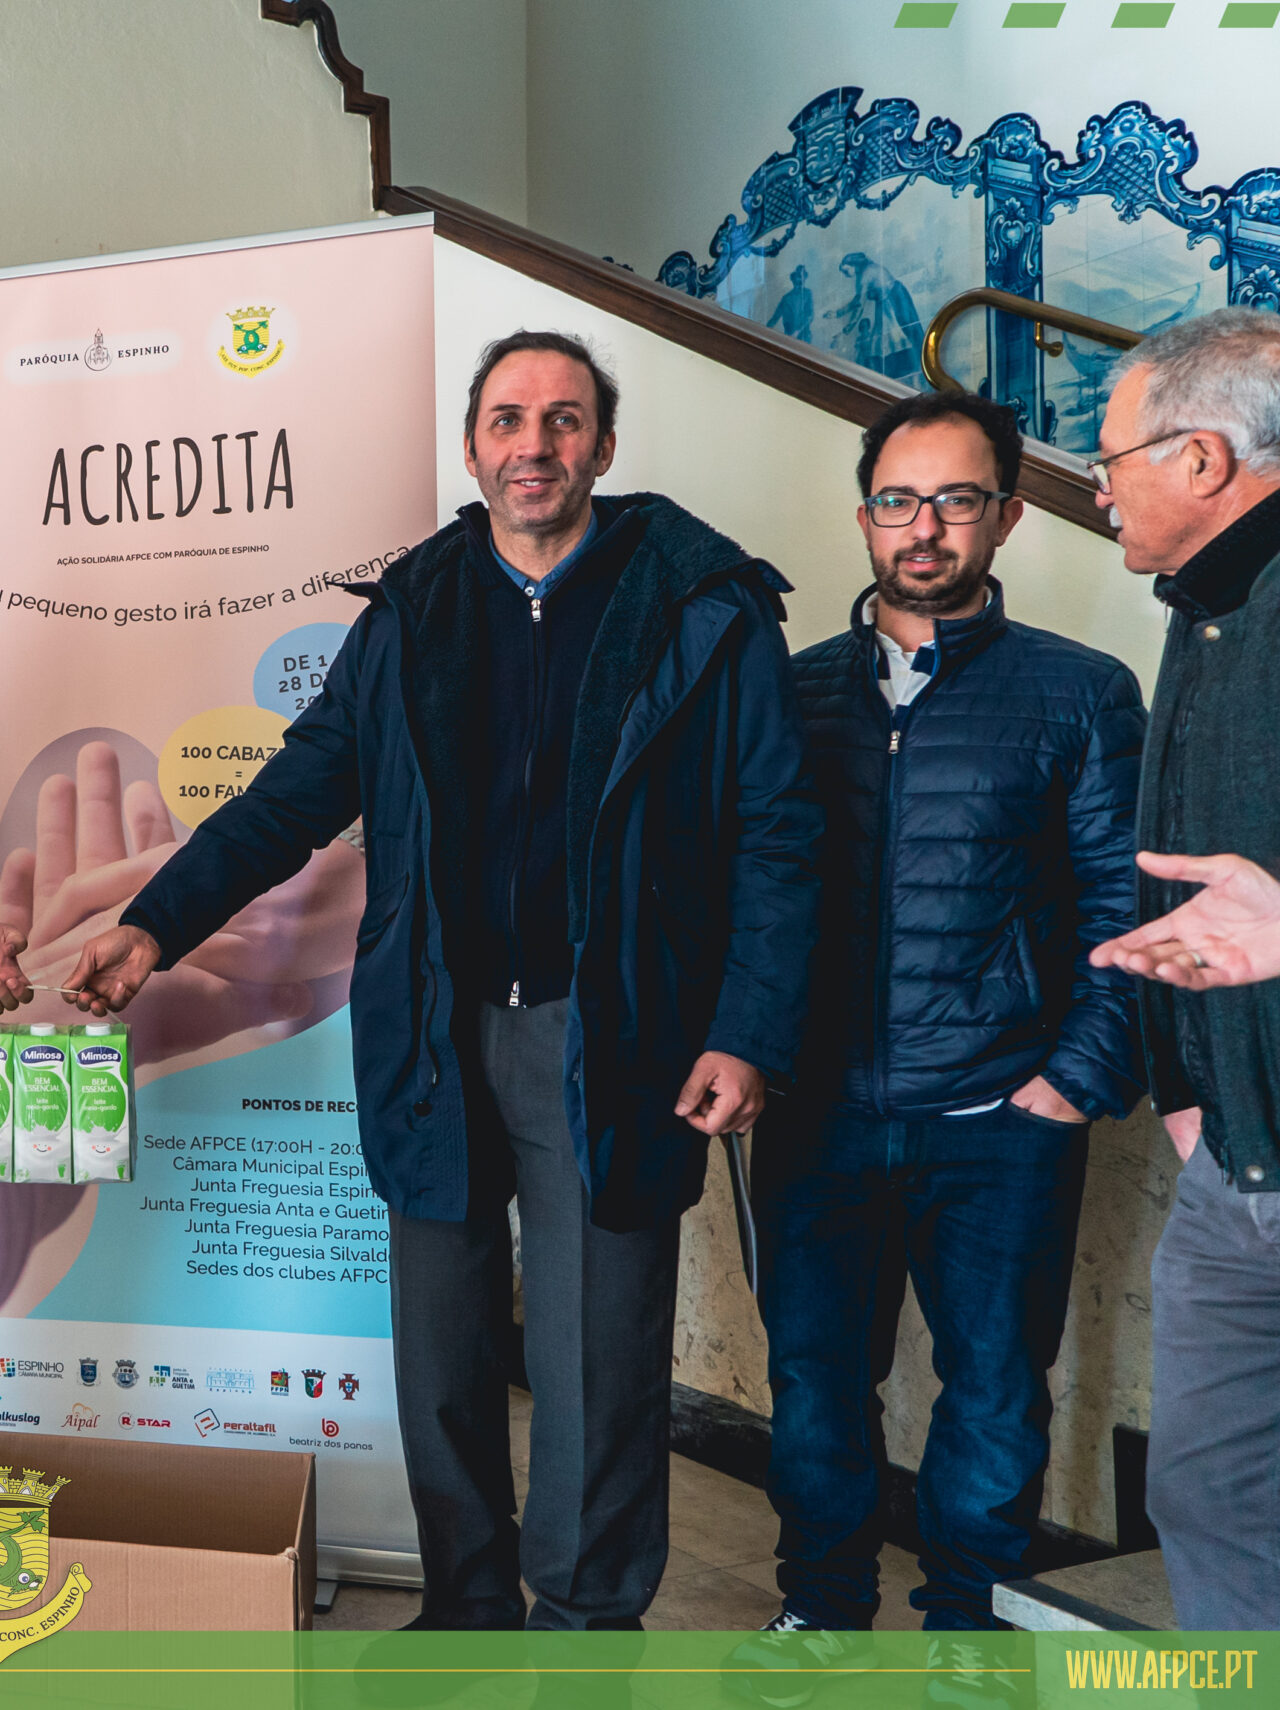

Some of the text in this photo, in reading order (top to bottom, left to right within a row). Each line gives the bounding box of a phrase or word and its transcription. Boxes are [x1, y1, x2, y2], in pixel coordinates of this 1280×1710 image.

[19, 344, 170, 367] PARÓQUIA ESPINHO
[42, 428, 294, 526] ACREDITA
[56, 544, 270, 566] AÇÃO SOLIDÁRIA AFPCE COM PARÓQUIA DE ESPINHO
[7, 592, 108, 621] pequeno
[114, 604, 177, 626] gesto
[184, 600, 212, 620] irá
[218, 592, 276, 616] fazer
[282, 588, 297, 603] a
[283, 654, 328, 673] DE 1
[278, 671, 328, 694] 28 D
[180, 745, 281, 761] 100 CABAZ
[179, 785, 210, 798] 100
[24, 1050, 62, 1061] Mimosa
[81, 1051, 119, 1061] Mimosa
[24, 1084, 60, 1092] ESSENCIAL
[34, 1076, 50, 1084] BEM
[81, 1085, 118, 1093] ESSENCIAL
[242, 1098, 360, 1113] PONTOS DE REC
[144, 1134, 186, 1150] Sede
[190, 1136, 247, 1151] AFPCE
[251, 1137, 313, 1155] (17:00H
[173, 1156, 238, 1172] Câmara
[242, 1158, 325, 1178] Municipal
[191, 1178, 380, 1201] Junta Freguesia Espin
[140, 1196, 185, 1212] Junta
[190, 1198, 271, 1217] Freguesia
[275, 1201, 315, 1217] Anta
[320, 1206, 330, 1218] e
[184, 1219, 389, 1241] Junta Freguesia Paramo
[192, 1239, 390, 1263] Junta Freguesia Silvald
[186, 1260, 239, 1276] Sedes
[243, 1262, 274, 1278] dos
[278, 1264, 336, 1281] clubes
[17, 1360, 65, 1373] ESPINHO
[172, 1376, 188, 1384] ANTA
[60, 1414, 101, 1432] Aipal
[137, 1418, 171, 1428] STAR
[289, 1436, 322, 1448] beatriz
[323, 1438, 341, 1449] dos
